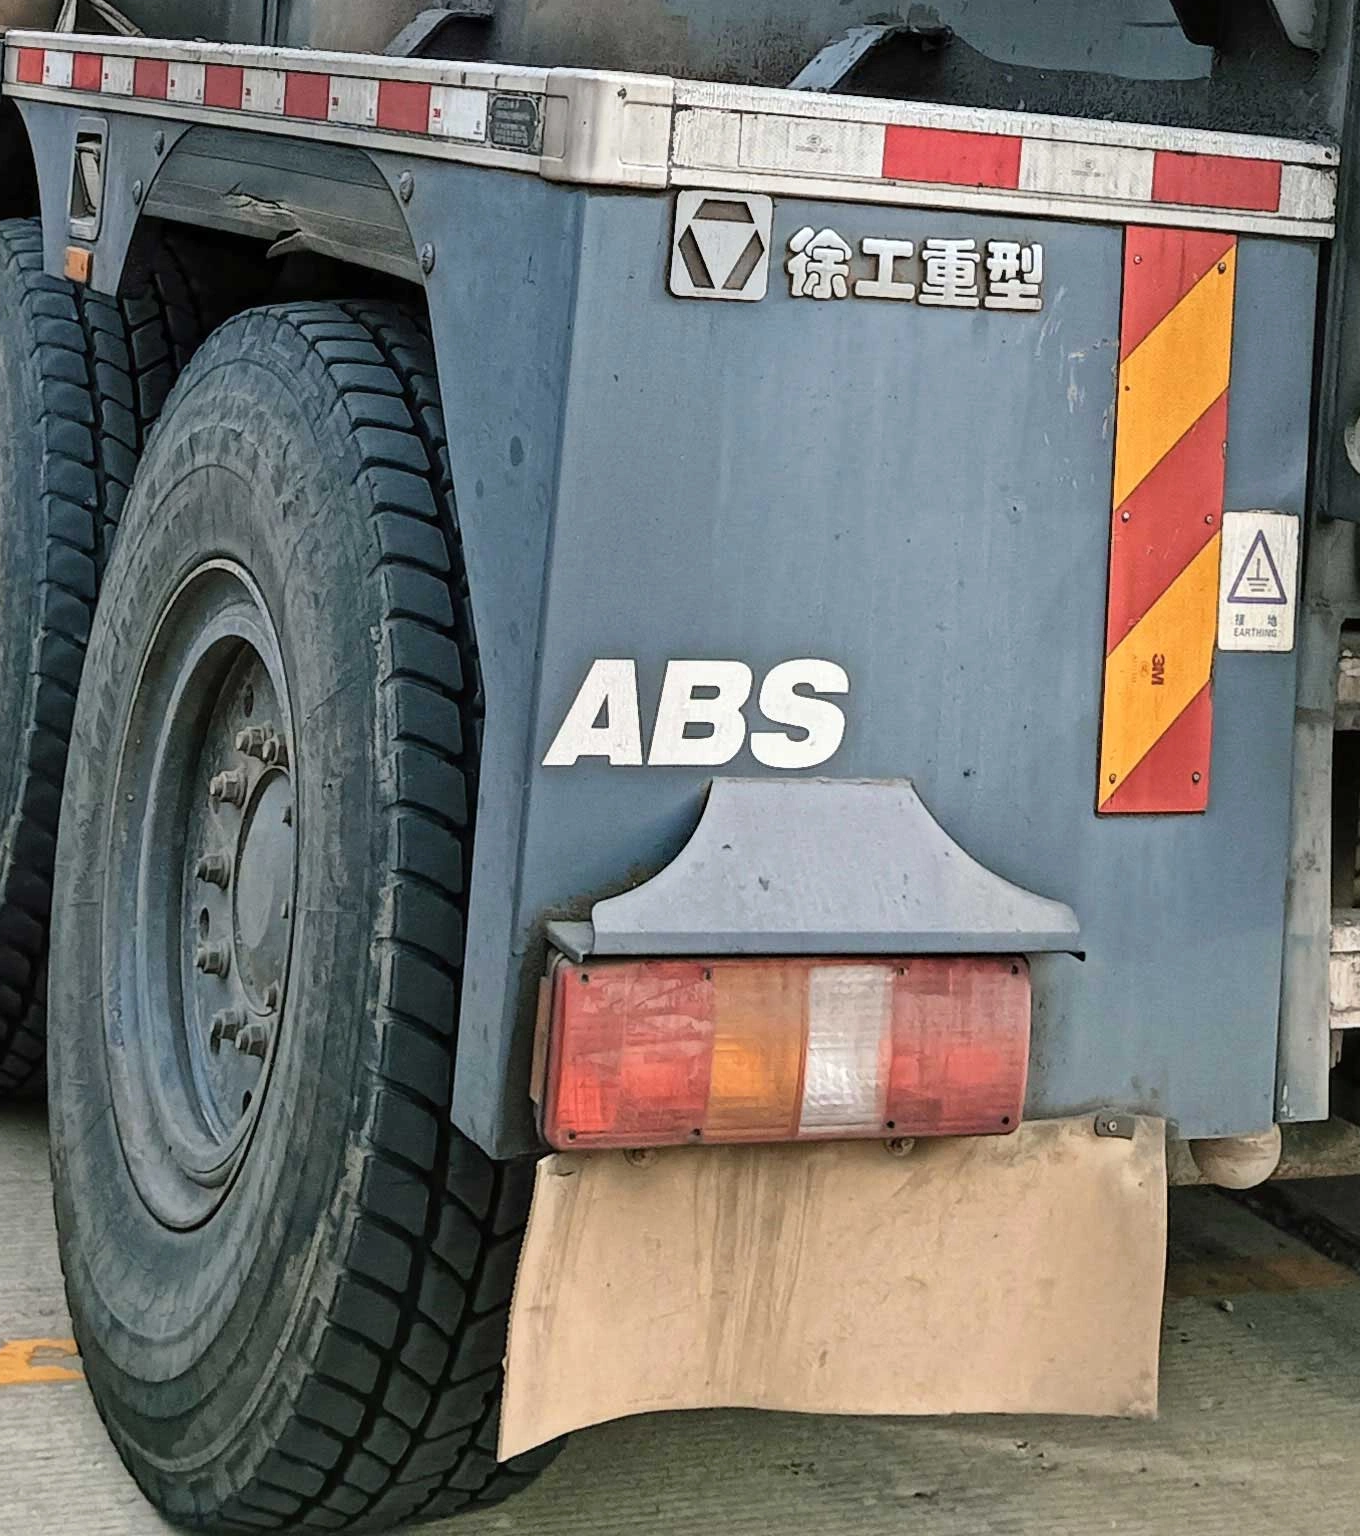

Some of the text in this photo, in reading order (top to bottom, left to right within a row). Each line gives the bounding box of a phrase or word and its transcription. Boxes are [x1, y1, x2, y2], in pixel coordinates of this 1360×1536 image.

[787, 225, 1043, 311] 徐工重型
[1233, 627, 1278, 638] EARTHING
[1151, 653, 1165, 685] 3M
[542, 659, 850, 770] ABS
